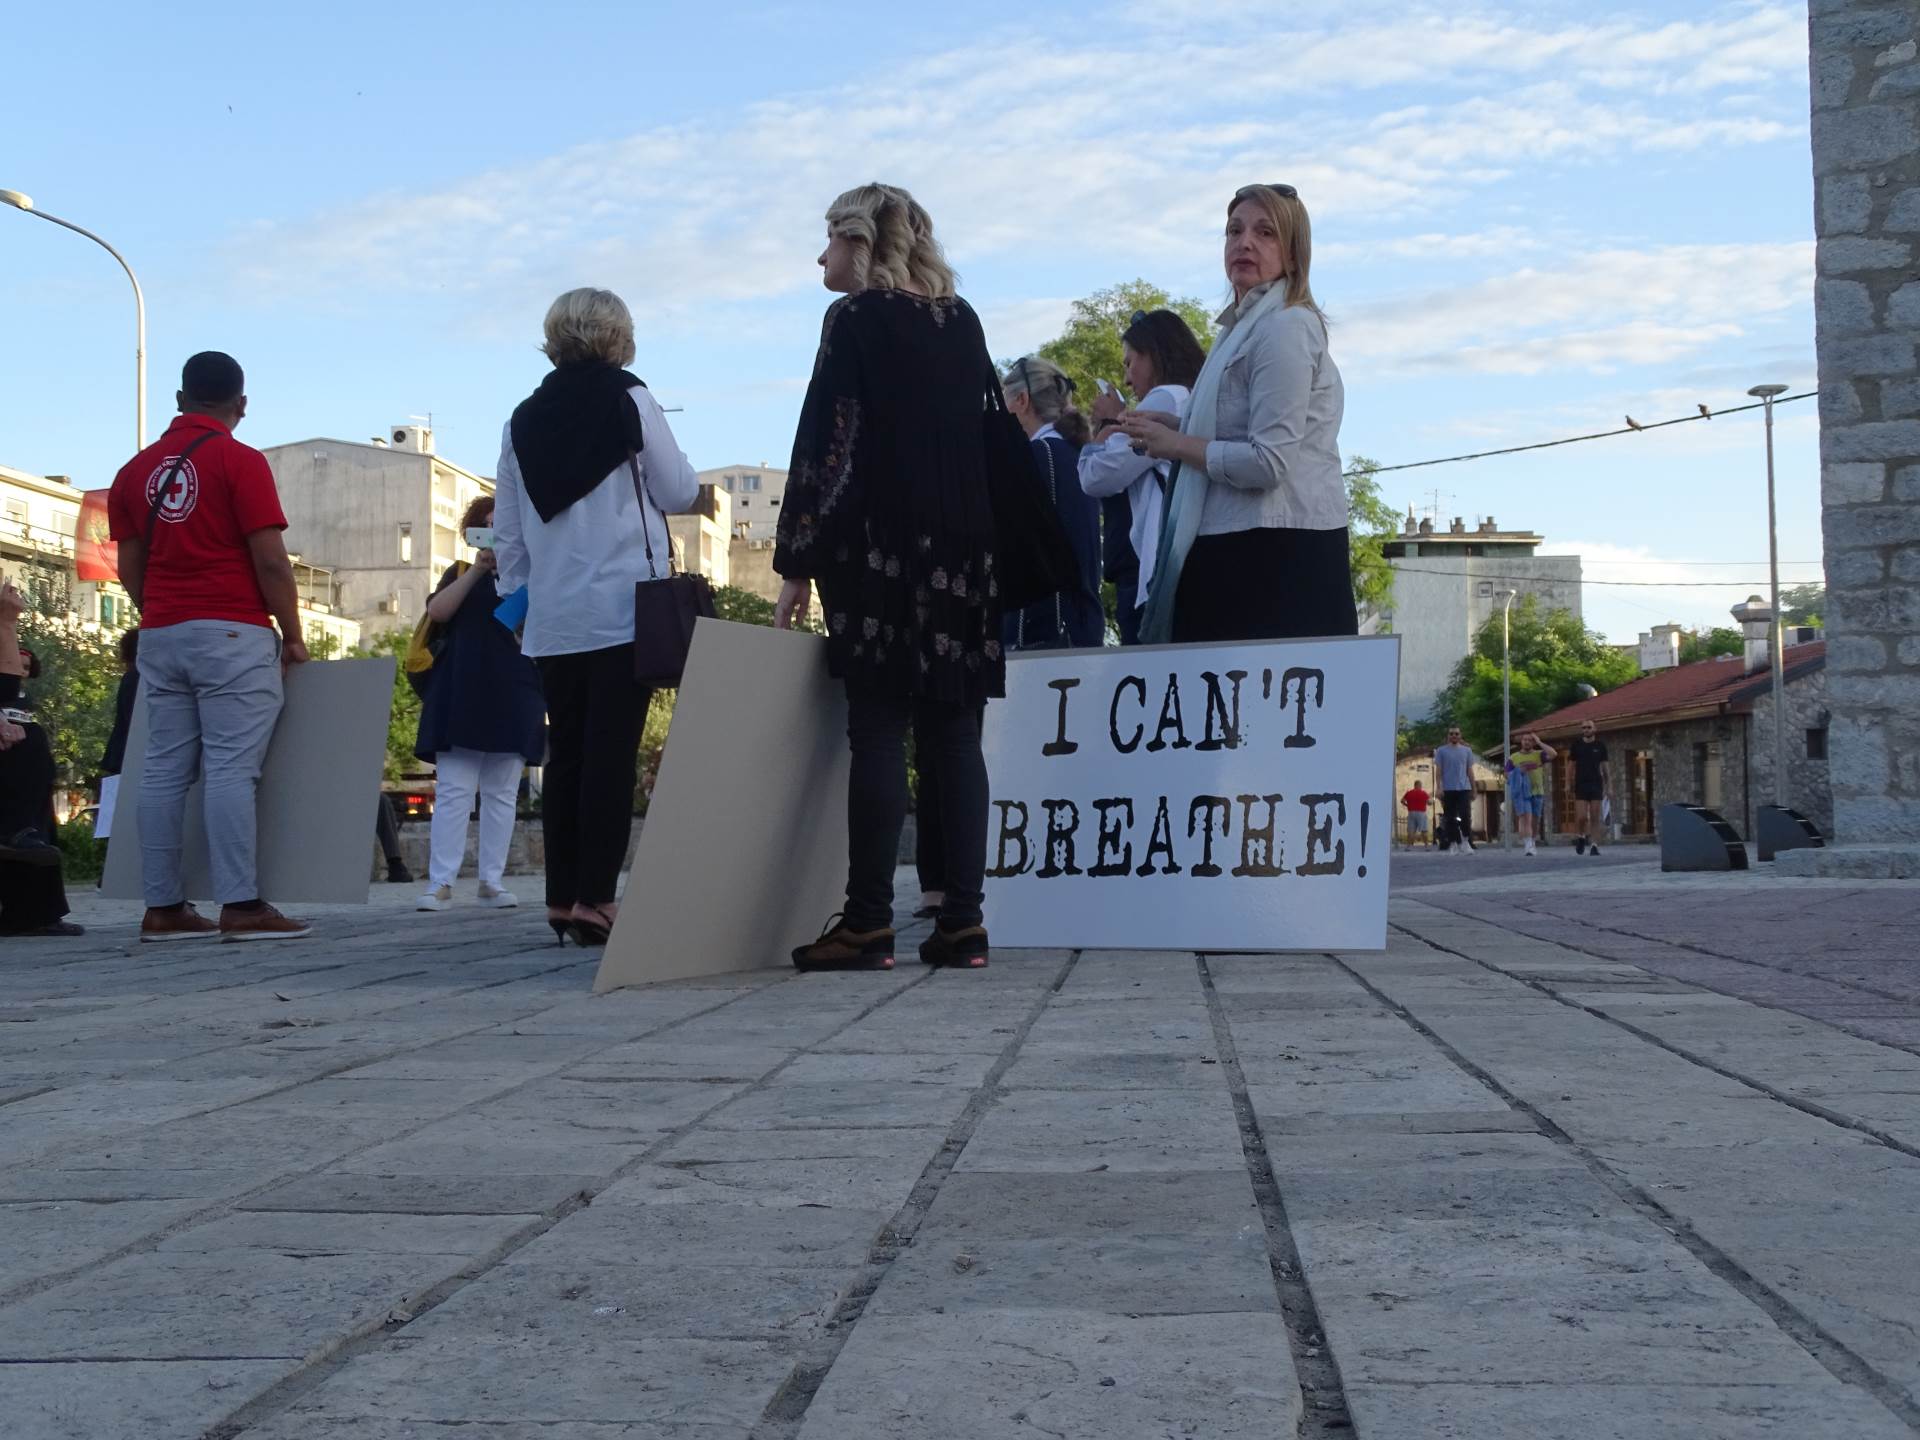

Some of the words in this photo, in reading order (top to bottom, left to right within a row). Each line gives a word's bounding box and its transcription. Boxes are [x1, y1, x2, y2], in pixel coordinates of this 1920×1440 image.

[1042, 678, 1081, 756] I
[1109, 667, 1325, 754] CAN'T
[985, 793, 1370, 878] BREATHE!
